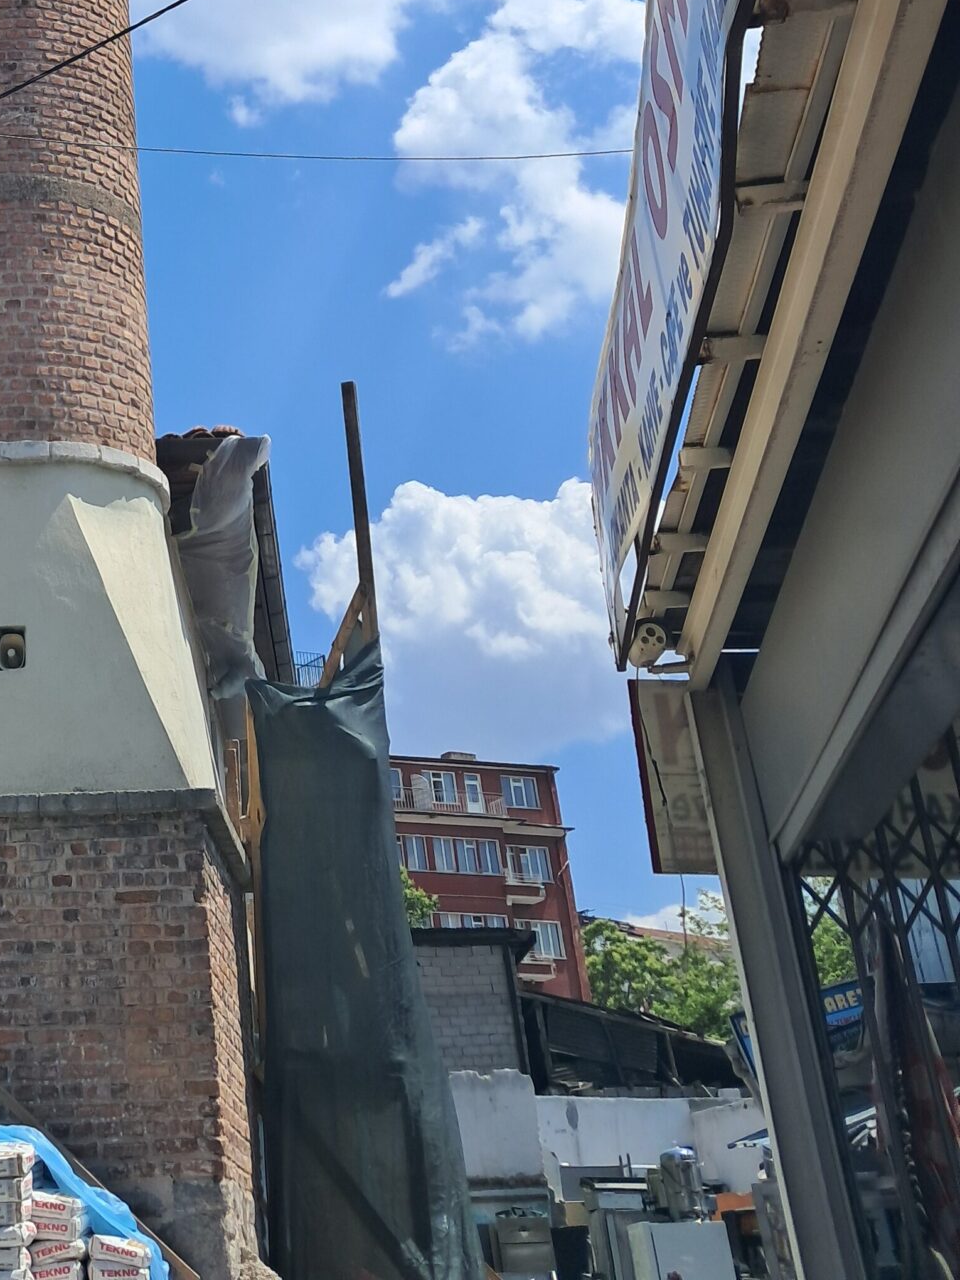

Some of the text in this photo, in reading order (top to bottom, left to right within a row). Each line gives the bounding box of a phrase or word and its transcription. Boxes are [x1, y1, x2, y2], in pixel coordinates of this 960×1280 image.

[638, 368, 664, 480] KAHVE
[660, 280, 683, 387] CAFE
[677, 252, 693, 315] ve
[32, 1200, 66, 1211] TEKNO
[35, 1221, 68, 1232] TEKNO
[34, 1242, 71, 1258] TEKNO
[100, 1242, 138, 1258] TEKNO
[34, 1266, 71, 1280] TEKNO
[101, 1268, 140, 1277] TEKNO
